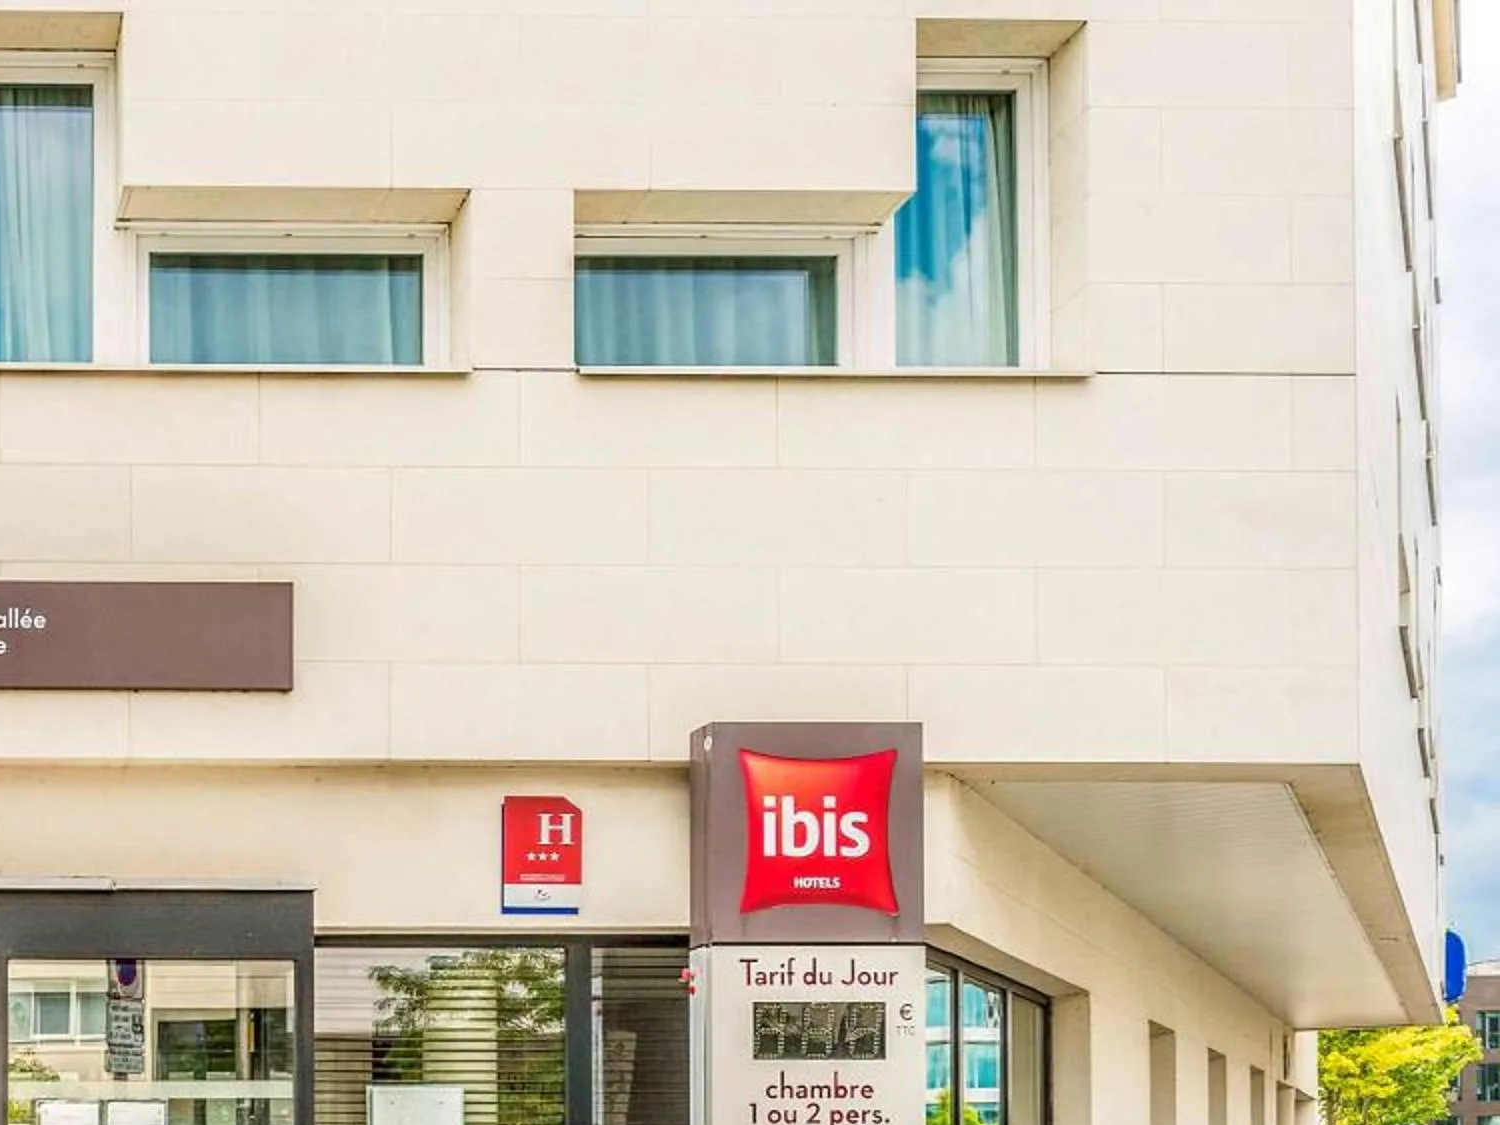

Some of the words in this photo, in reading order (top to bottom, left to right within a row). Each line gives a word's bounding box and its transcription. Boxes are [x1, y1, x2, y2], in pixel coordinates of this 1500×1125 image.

[537, 813, 575, 845] H
[763, 795, 871, 858] ibis
[793, 876, 841, 889] HOTELS
[739, 957, 796, 986] Tarif
[802, 957, 833, 986] du
[841, 958, 899, 986] Jour
[899, 1003, 913, 1021] €
[765, 1071, 875, 1099] chambre
[749, 1103, 757, 1124] 1
[767, 1109, 797, 1124] ou
[806, 1103, 821, 1124] 2
